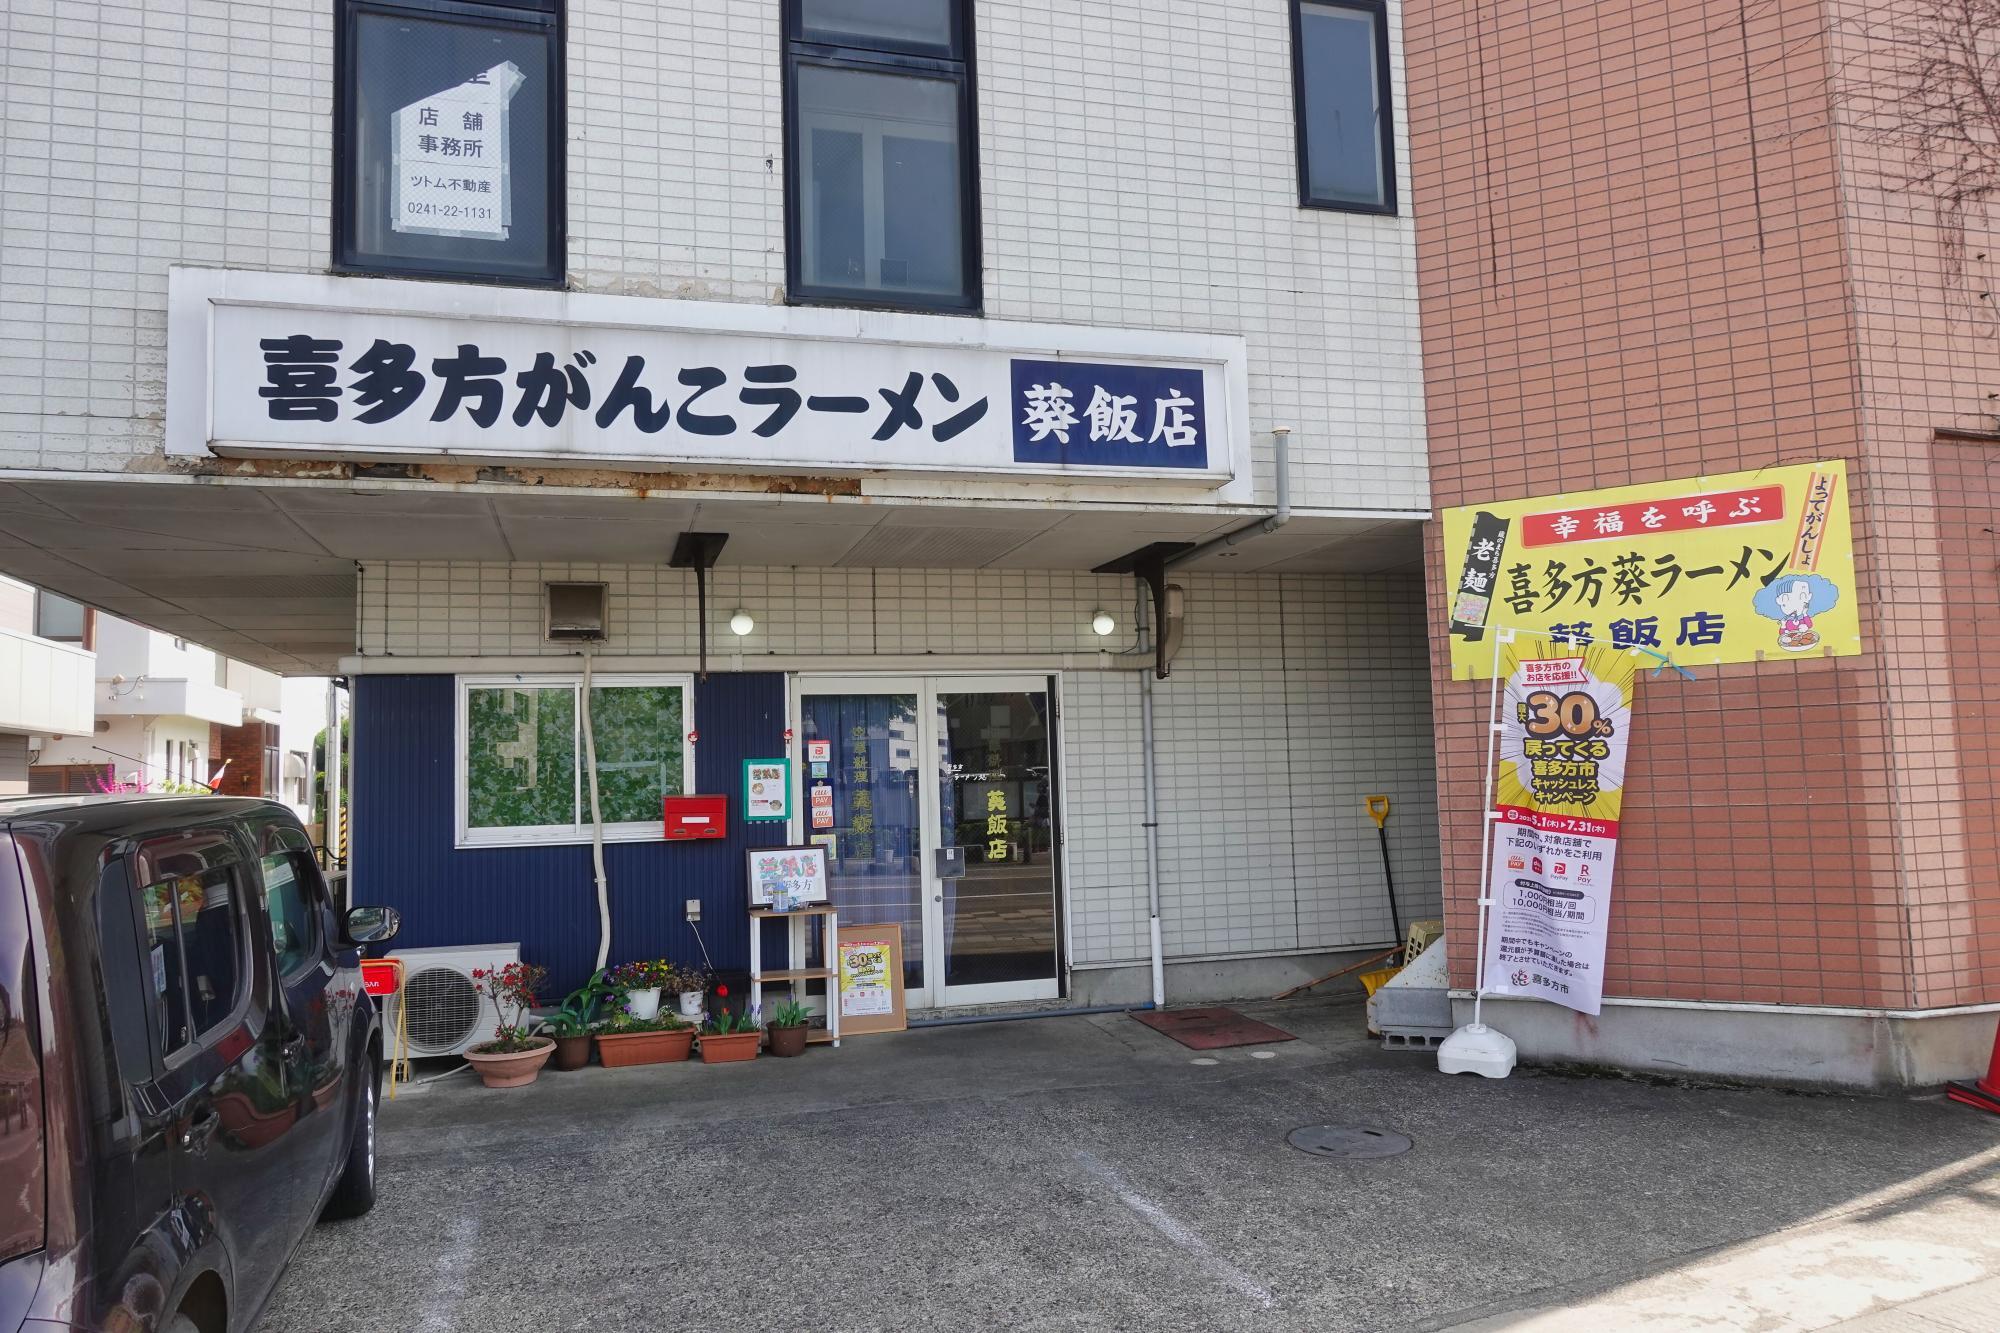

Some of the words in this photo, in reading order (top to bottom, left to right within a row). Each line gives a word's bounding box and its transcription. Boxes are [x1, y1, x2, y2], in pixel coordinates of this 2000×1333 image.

[418, 134, 484, 158] 事務所
[410, 175, 492, 193] ツトム不動産
[408, 202, 492, 219] 0241-22-1131
[258, 334, 988, 442] 喜多方がんこラーメン
[1021, 382, 1197, 448] 葵飯店
[1550, 496, 1761, 539] 幸福を呼ぶ
[1801, 476, 1828, 565] よってがんしょ
[1463, 537, 1495, 593] 老麺
[1504, 545, 1791, 614] 喜多方葵ラーメン
[1526, 662, 1571, 673] 喜多方市の
[1527, 692, 1612, 736] 30%
[1525, 740, 1607, 756] 戻ってくる
[1533, 762, 1595, 776] 喜多方市
[814, 788, 828, 796] au
[1533, 778, 1598, 789] キャッシュレス
[1535, 791, 1594, 802] キャンペーン
[815, 809, 829, 817] au
[987, 790, 1008, 859] 葵飯店
